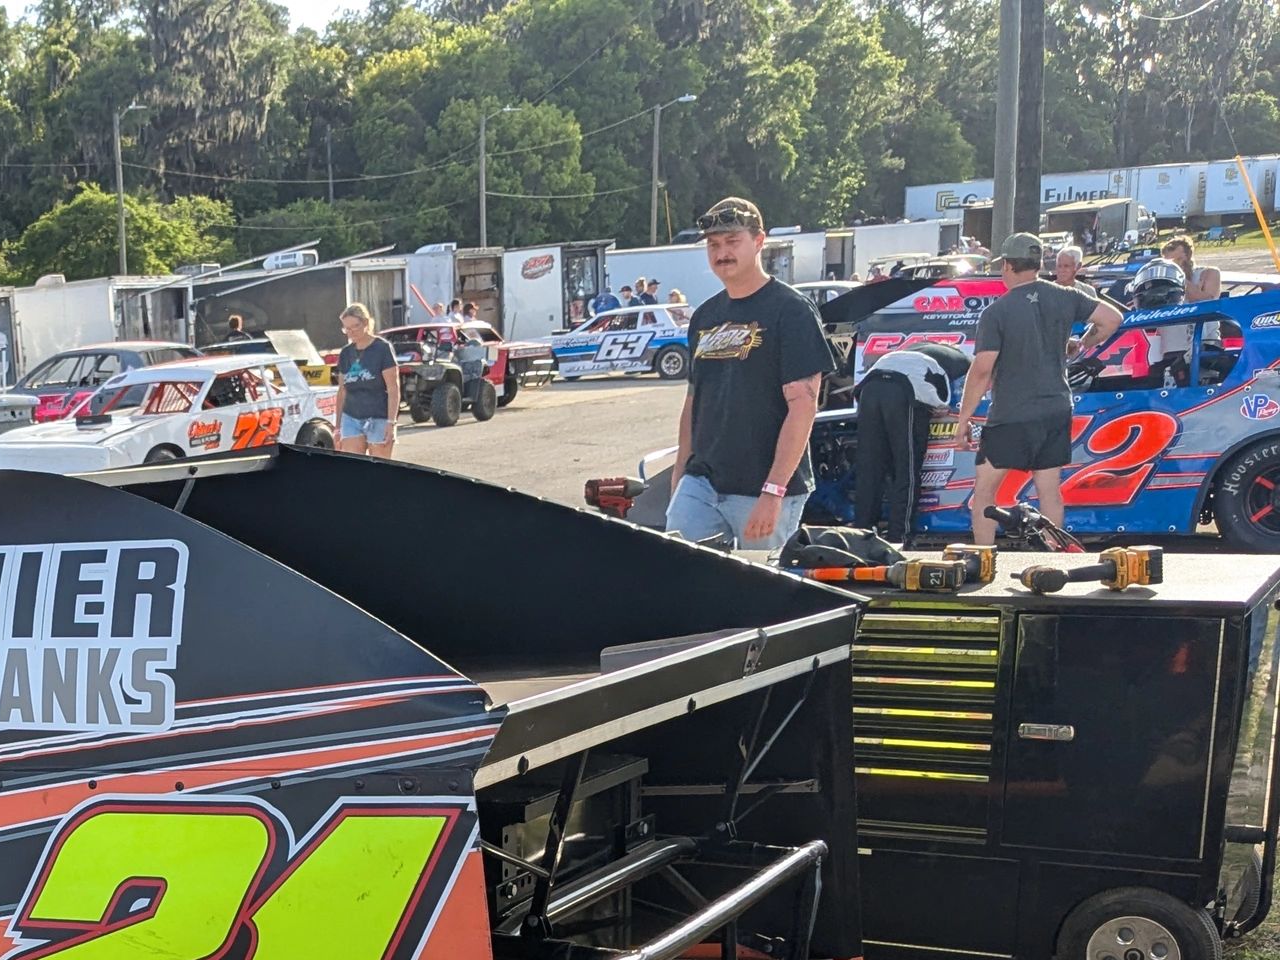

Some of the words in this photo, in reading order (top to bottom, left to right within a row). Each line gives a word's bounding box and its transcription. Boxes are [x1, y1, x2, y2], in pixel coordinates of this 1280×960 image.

[1123, 305, 1198, 325] Neiheiser
[595, 331, 656, 361] 63
[1243, 394, 1270, 420] VP
[929, 571, 942, 585] 21
